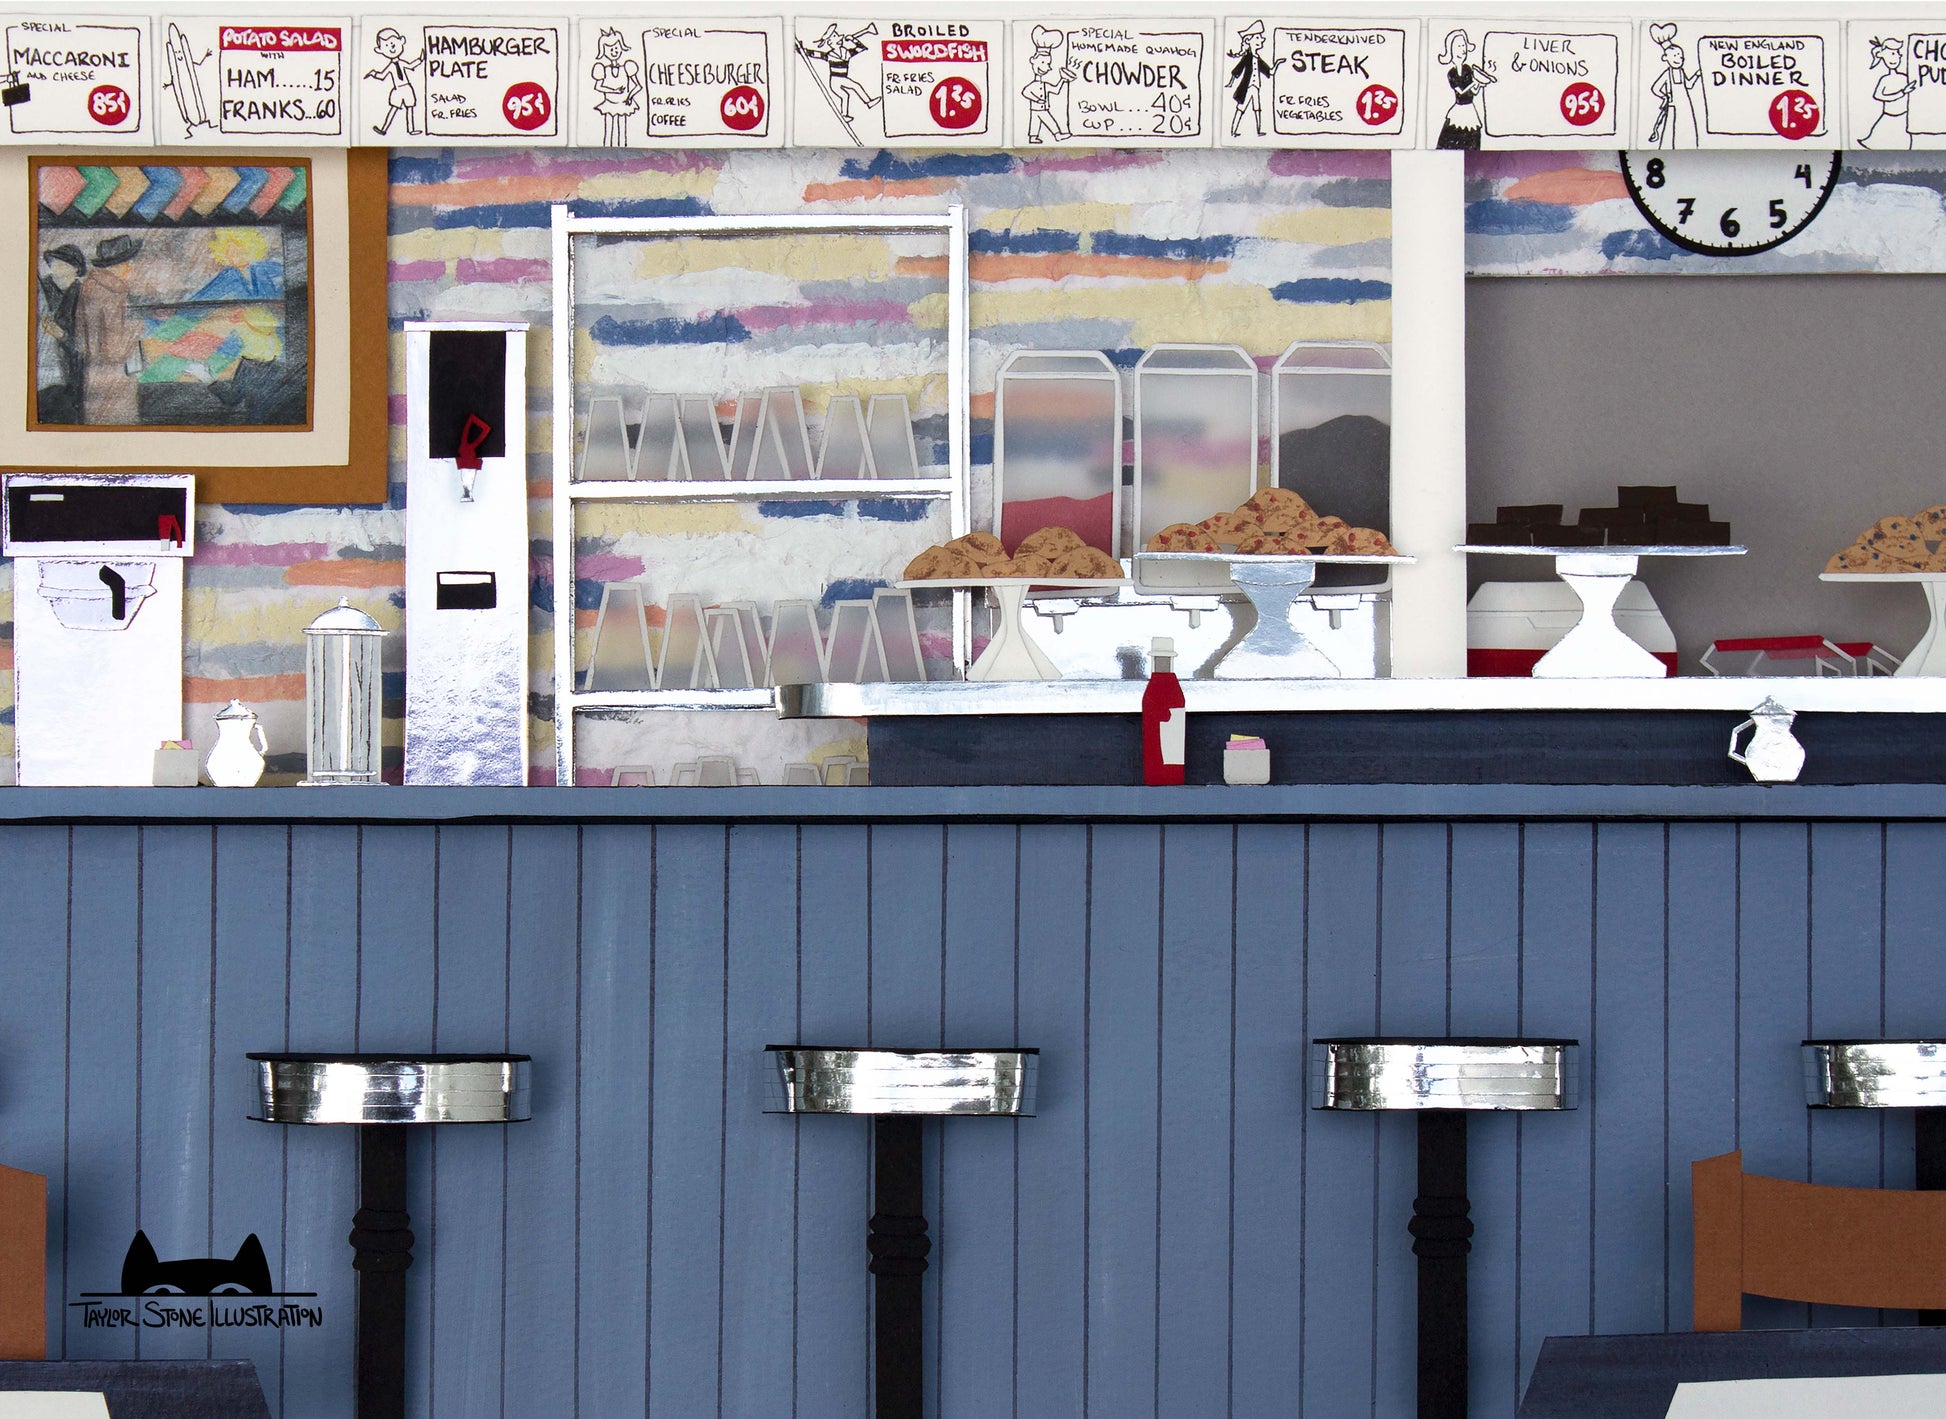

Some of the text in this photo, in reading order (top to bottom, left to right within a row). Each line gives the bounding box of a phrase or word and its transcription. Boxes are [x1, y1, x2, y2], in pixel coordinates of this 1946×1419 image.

[21, 22, 71, 32] SPECIAL
[653, 27, 701, 38] SPECIAL
[892, 23, 969, 38] BROILED
[1081, 27, 1134, 40] SPECIAL
[222, 28, 337, 48] POTATO SALAD
[428, 35, 550, 56] HAMBURGER
[1286, 32, 1385, 45] TENDERKNIVED
[1524, 37, 1575, 55] LIVER
[1709, 39, 1805, 51] NEW ENGLAND
[13, 48, 130, 68] MACCARONI
[886, 43, 986, 61] SWORDFISH
[1146, 46, 1196, 57] QUAHOG
[429, 60, 488, 79] PLATE
[1291, 50, 1369, 79] STEAK
[1721, 53, 1796, 70] BOILED
[27, 71, 97, 82] AND CHEESE
[649, 63, 765, 86] CHEESEBURGER
[904, 72, 935, 83] FRIES
[1083, 61, 1187, 89] CHOWDER
[1712, 71, 1809, 86] DINNER
[431, 93, 466, 104] SALAD
[886, 85, 922, 96] SALAD
[93, 92, 126, 116] 85¢
[507, 93, 544, 120] 95¢
[724, 95, 758, 118] 60¢
[1078, 101, 1124, 113] BOWL
[1151, 92, 1191, 113] 40¢
[1299, 95, 1330, 107] FRIES
[1565, 90, 1600, 117] 95¢
[450, 108, 477, 118] FRIES
[651, 114, 686, 126] COFFEE
[1277, 110, 1343, 122] VEGETABLES
[1083, 118, 1114, 131] CUP
[1152, 114, 1191, 134] 20¢
[1646, 157, 1665, 189] 8
[1794, 164, 1812, 189] 4
[1676, 198, 1696, 224] 7
[1769, 199, 1787, 229] 5
[1720, 208, 1741, 238] 6
